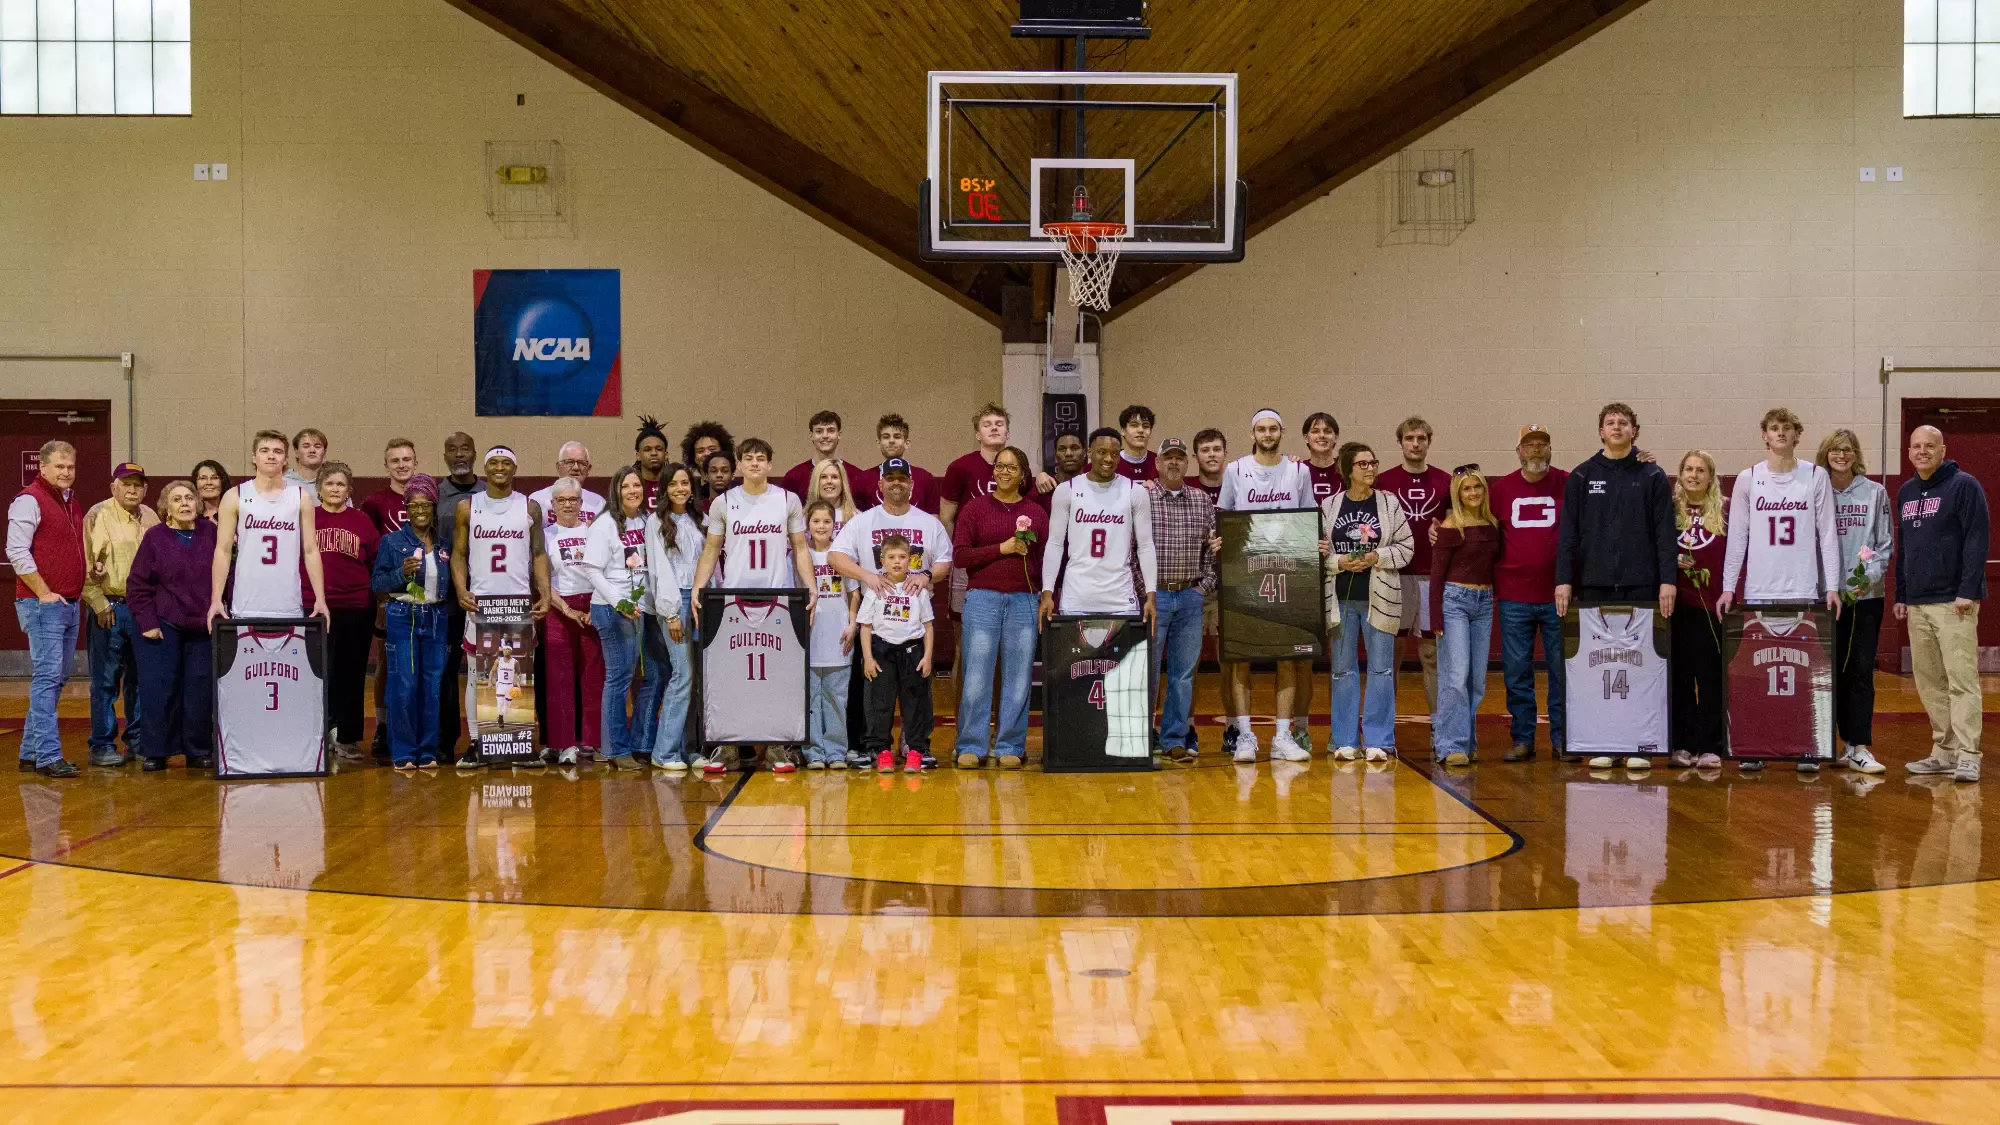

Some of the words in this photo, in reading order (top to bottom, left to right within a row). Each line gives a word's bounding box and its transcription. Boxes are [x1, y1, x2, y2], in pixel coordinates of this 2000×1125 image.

[513, 337, 591, 361] NCAA
[1247, 488, 1292, 503] Quakers
[1408, 488, 1426, 500] G
[1755, 496, 1809, 512] Quakers
[244, 513, 295, 531] Quakers
[1075, 508, 1125, 525] Quakers
[1510, 496, 1556, 529] G
[473, 524, 524, 540] Quakers
[732, 519, 783, 536] Quakers
[1768, 516, 1795, 547] 13
[261, 535, 278, 566] 3
[1090, 528, 1106, 559] 8
[1335, 541, 1378, 553] COLLGE
[490, 543, 507, 573] 2
[748, 539, 767, 570] 11
[1258, 573, 1287, 603] 41
[477, 598, 509, 607] GUILFORD
[509, 598, 530, 607] MEN'S
[483, 606, 525, 615] BASKETBALL
[486, 615, 522, 623] 2025-2026
[730, 632, 783, 652] GUILFORD
[746, 652, 768, 681] 11
[1588, 648, 1643, 668] GUILFORD
[1753, 646, 1810, 667] GUILFORD
[244, 661, 300, 682] GUILFORD
[1766, 665, 1796, 696] 13
[1602, 669, 1630, 700] 14
[264, 681, 280, 712] 3
[482, 733, 513, 743] DAWSON
[517, 730, 532, 740] #2
[482, 741, 533, 756] EDWARDS
